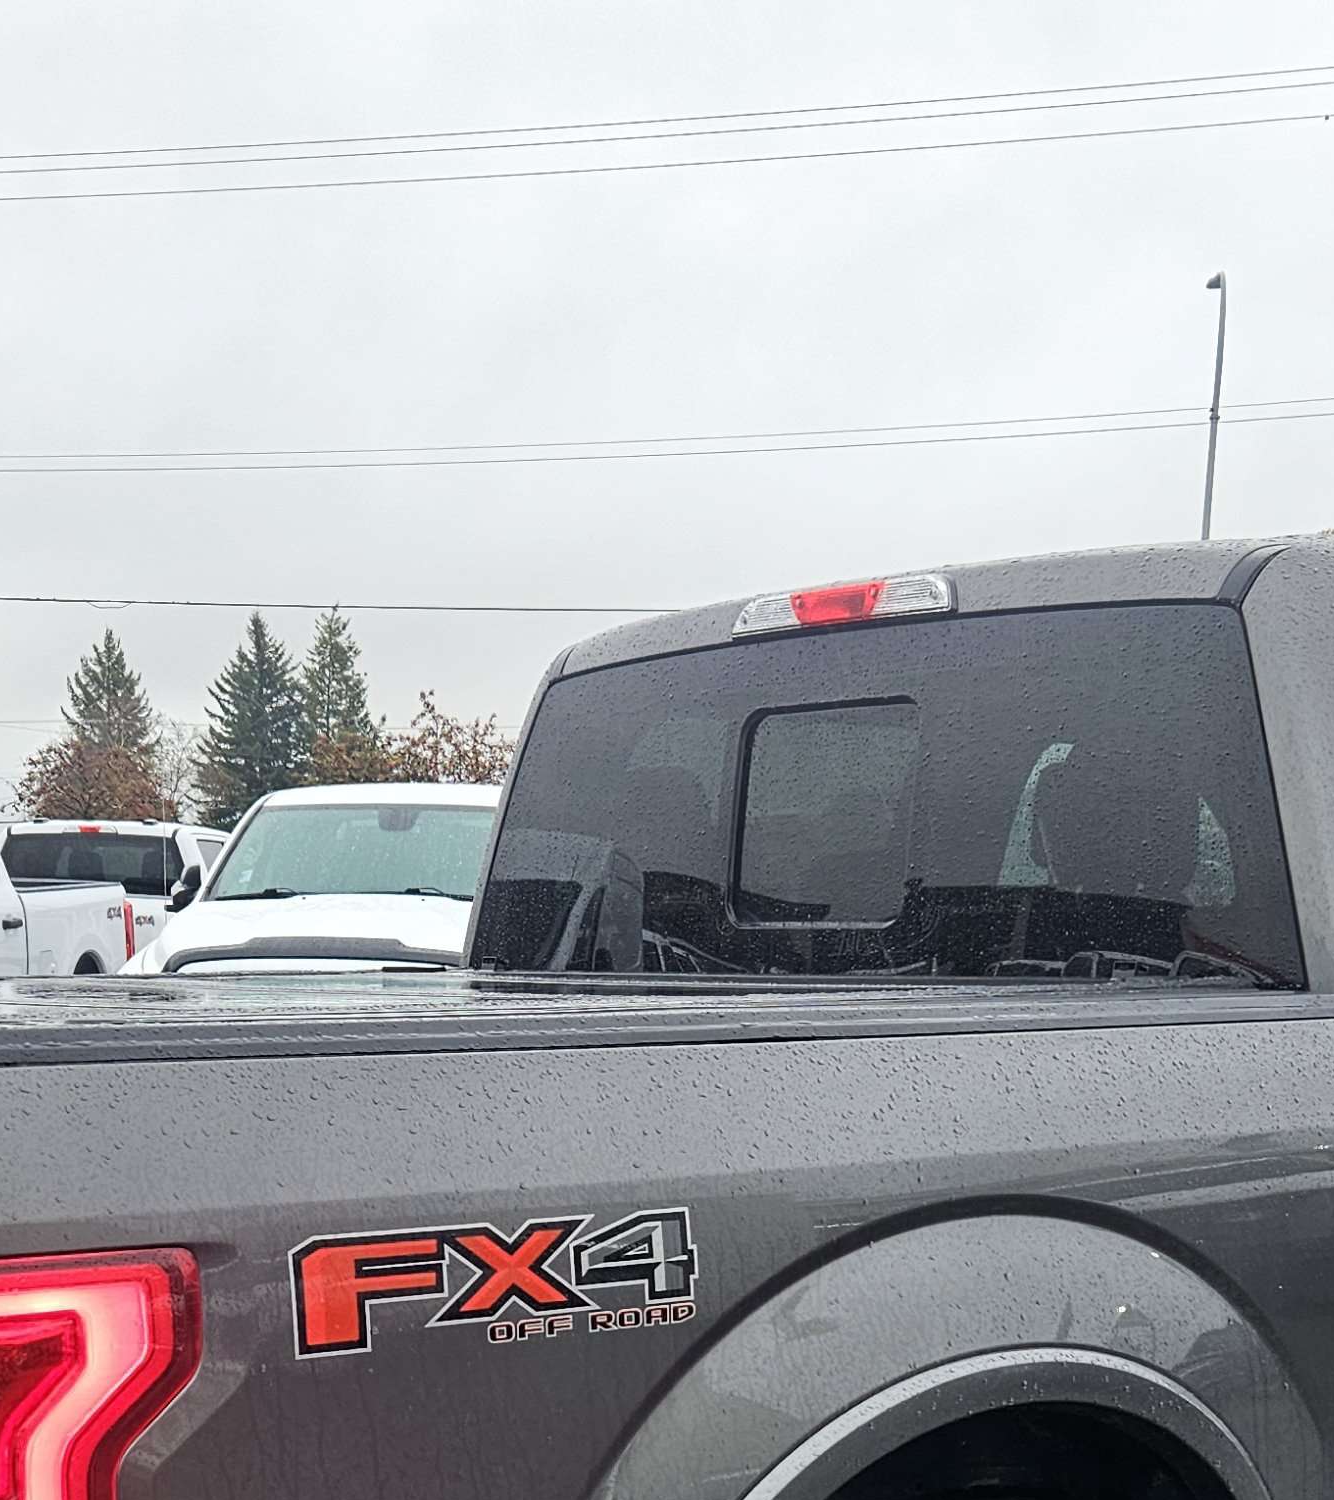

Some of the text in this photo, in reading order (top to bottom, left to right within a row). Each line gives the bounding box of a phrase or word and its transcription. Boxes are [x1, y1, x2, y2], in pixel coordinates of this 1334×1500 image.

[288, 1207, 698, 1359] FX4
[488, 1302, 696, 1343] OFF ROAD
